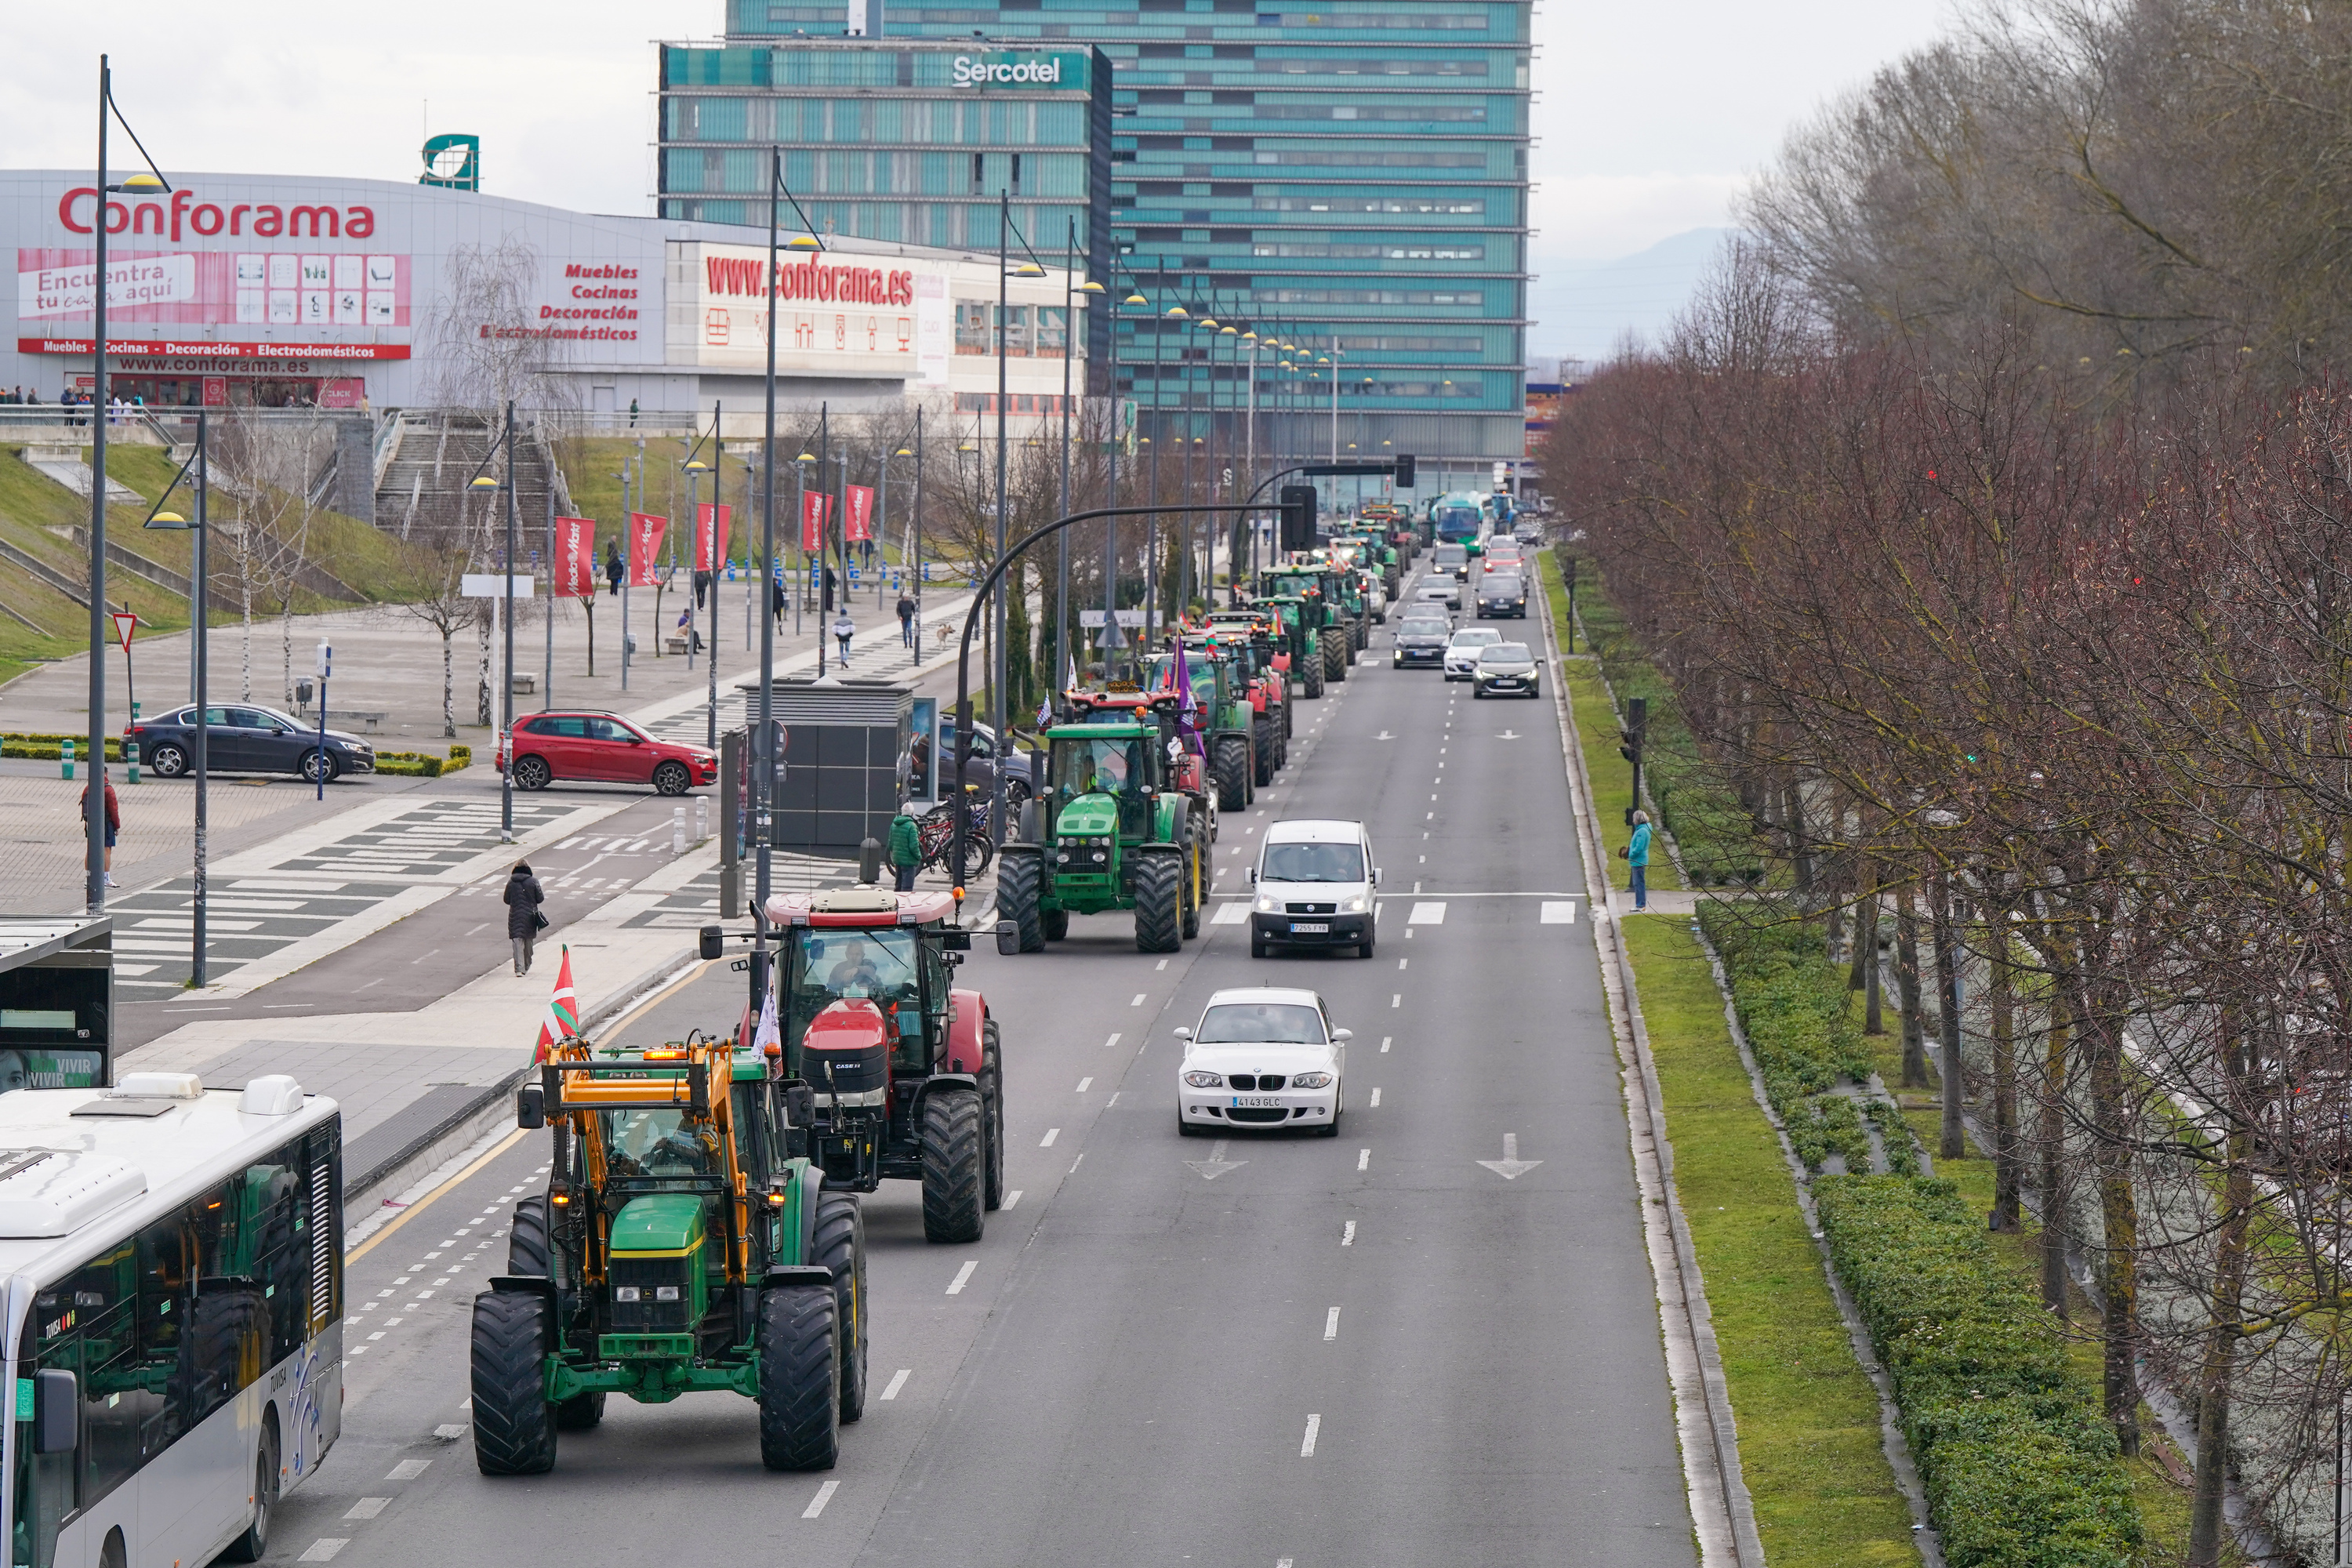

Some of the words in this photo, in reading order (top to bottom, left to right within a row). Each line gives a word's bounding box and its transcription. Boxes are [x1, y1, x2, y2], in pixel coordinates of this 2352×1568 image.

[953, 56, 1060, 87] Sercotel
[59, 187, 374, 242] Conforama
[38, 264, 164, 292] Encuentra
[565, 264, 638, 278] Muebles
[707, 251, 913, 307] www.conforama.es
[36, 294, 58, 309] tu
[125, 277, 172, 303] aquí
[572, 285, 637, 299] Cocinas
[539, 305, 638, 320] Decoración
[480, 325, 638, 340] Electrodomésticos
[44, 341, 87, 352] Muebles
[104, 342, 149, 354] Cocinas
[165, 343, 240, 355] Decoración
[257, 344, 375, 358] Electrodomésticos
[119, 357, 310, 373] www.conforama.es
[31, 1058, 92, 1073] CONVIVIR
[31, 1072, 92, 1087] VIVIRCON
[1238, 1098, 1261, 1107] 4143
[1263, 1098, 1280, 1107] GLC
[45, 1318, 61, 1341] TUVISA
[270, 1366, 287, 1395] TUVISA
